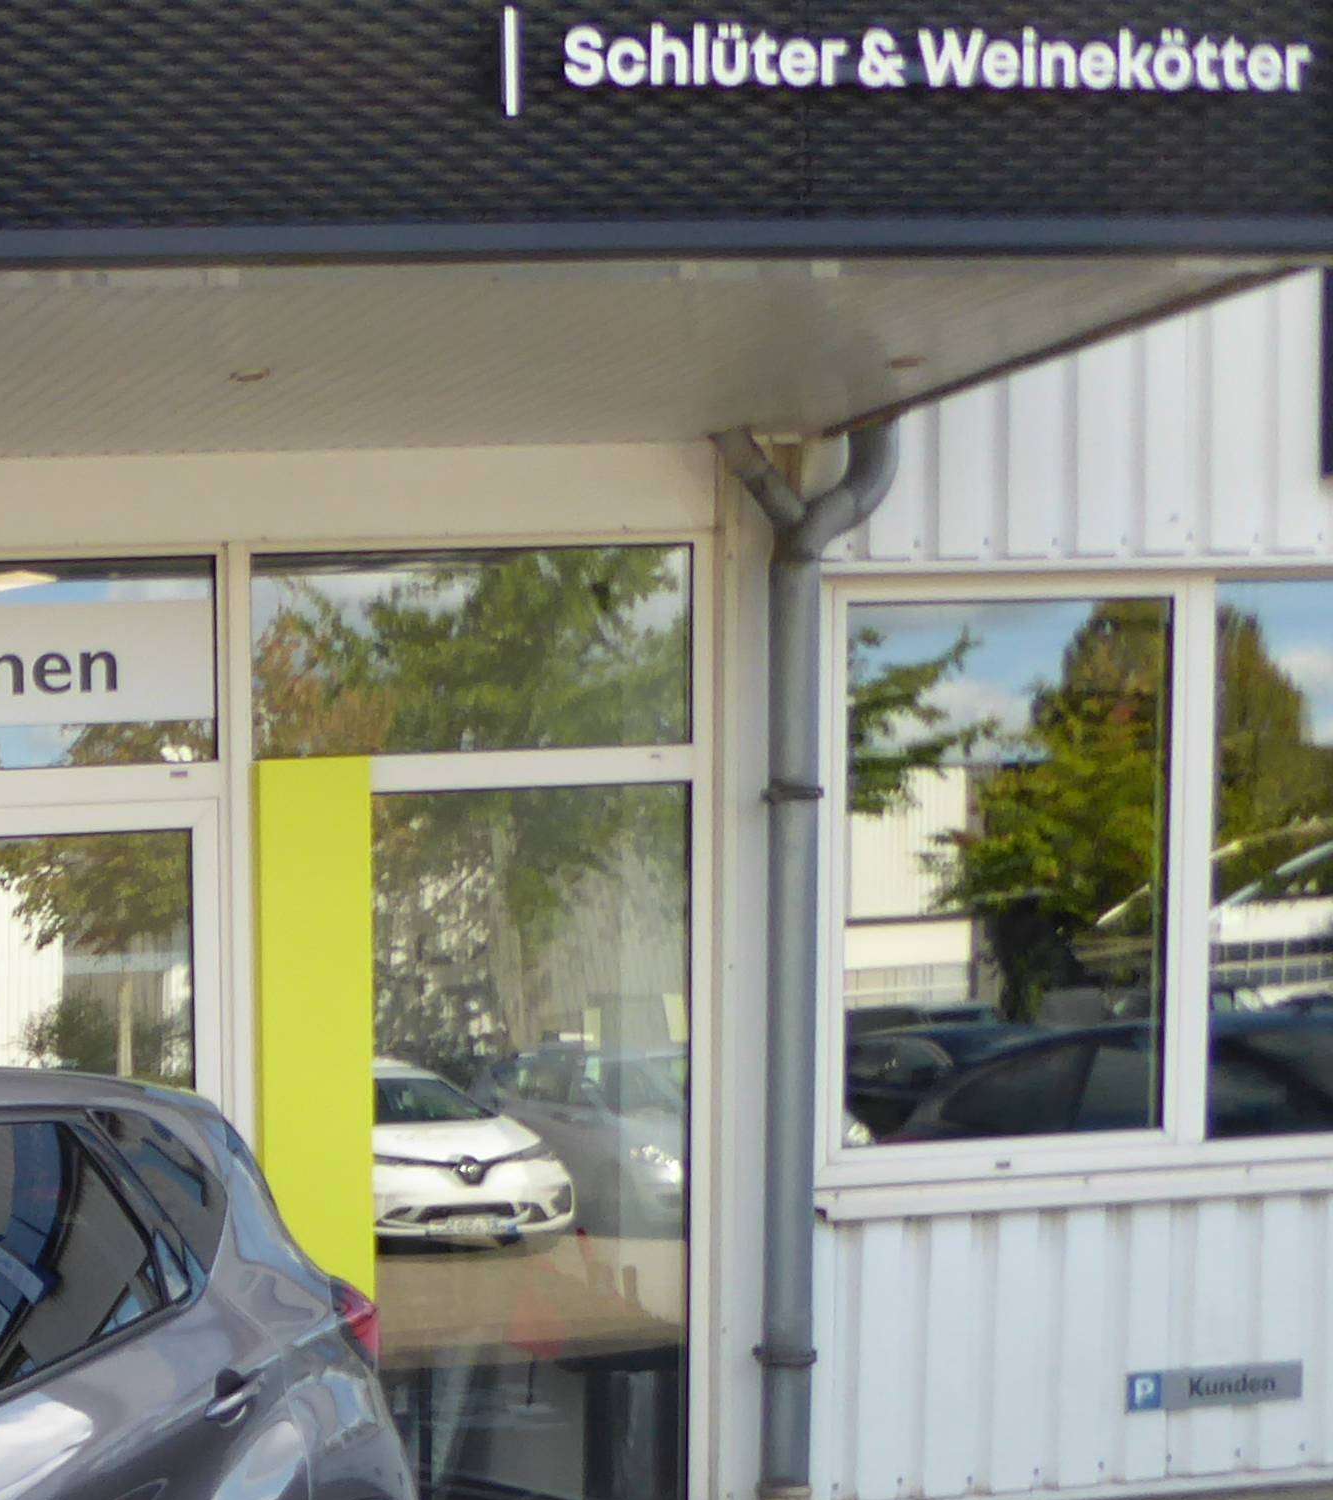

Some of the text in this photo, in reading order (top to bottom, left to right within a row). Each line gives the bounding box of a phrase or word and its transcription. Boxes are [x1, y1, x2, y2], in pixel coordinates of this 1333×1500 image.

[564, 23, 1312, 91] Schlüter & Weinekötter
[1188, 1373, 1276, 1398] Kunden
